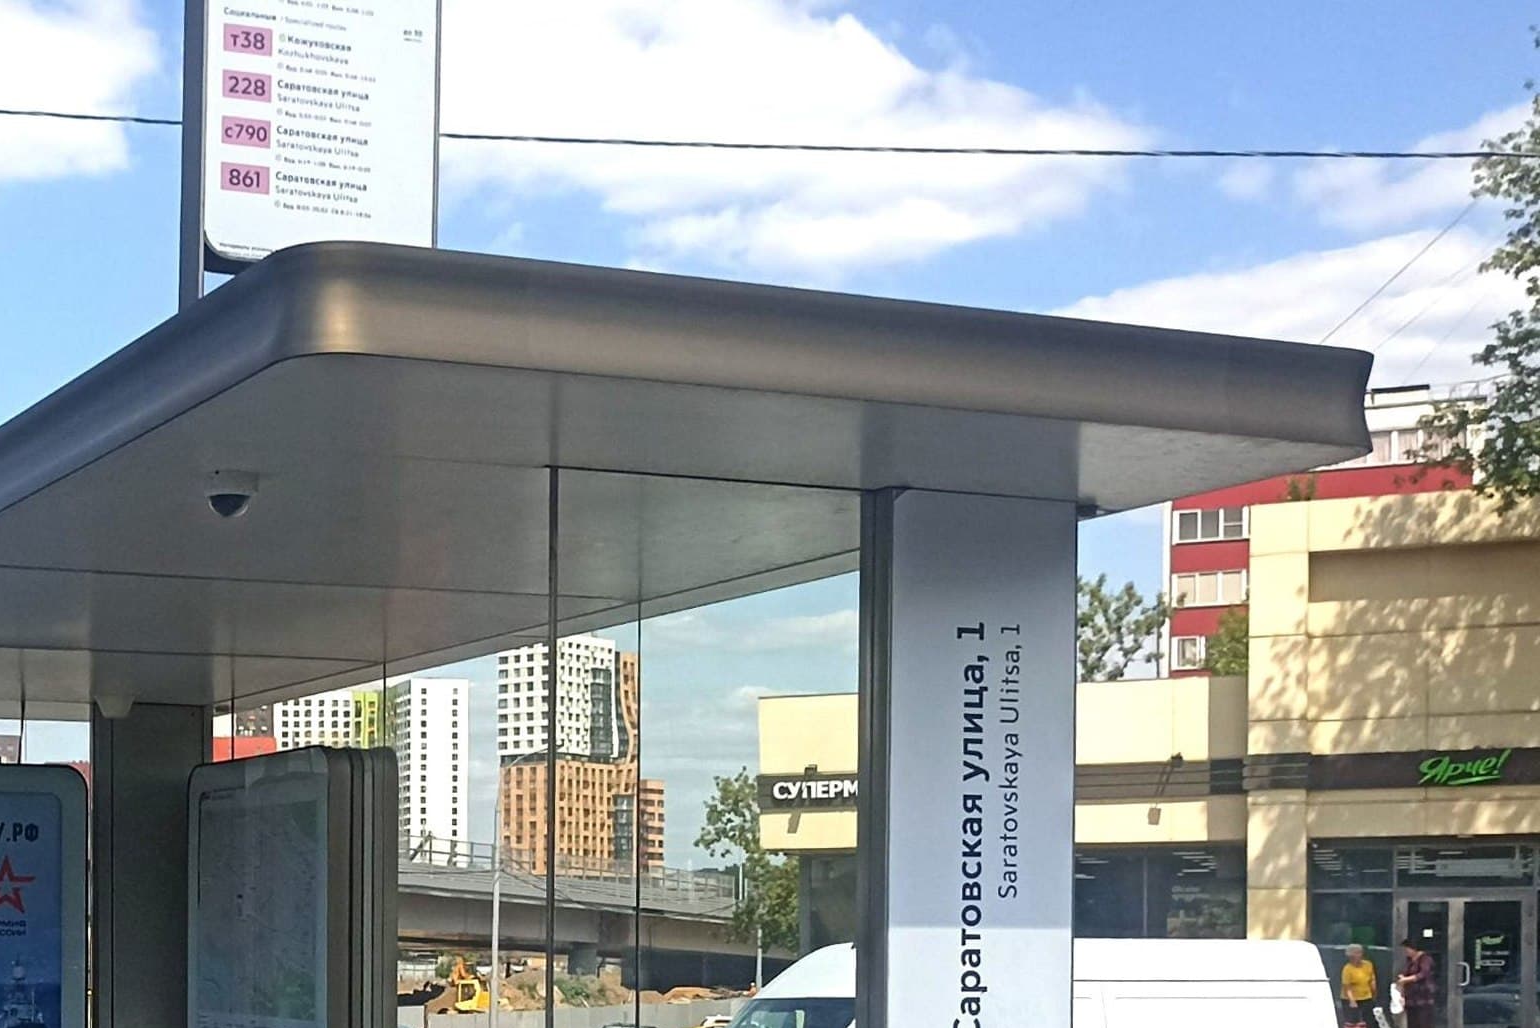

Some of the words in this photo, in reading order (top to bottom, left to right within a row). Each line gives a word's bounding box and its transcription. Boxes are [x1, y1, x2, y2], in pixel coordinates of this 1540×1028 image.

[228, 76, 266, 96] 228
[278, 80, 339, 95] Саратовская
[341, 89, 369, 101] улица
[276, 125, 338, 141] Саратовская
[340, 134, 368, 146] улица
[229, 168, 261, 188] 861
[276, 172, 337, 187] Саратовская
[339, 181, 367, 192] улица
[958, 622, 986, 641] 1
[1002, 623, 1020, 633] 1
[1001, 644, 1022, 723] Ulitsa,
[958, 654, 989, 789] улица,
[1419, 748, 1512, 784] Ярче!
[999, 734, 1023, 899] Saratovskaya
